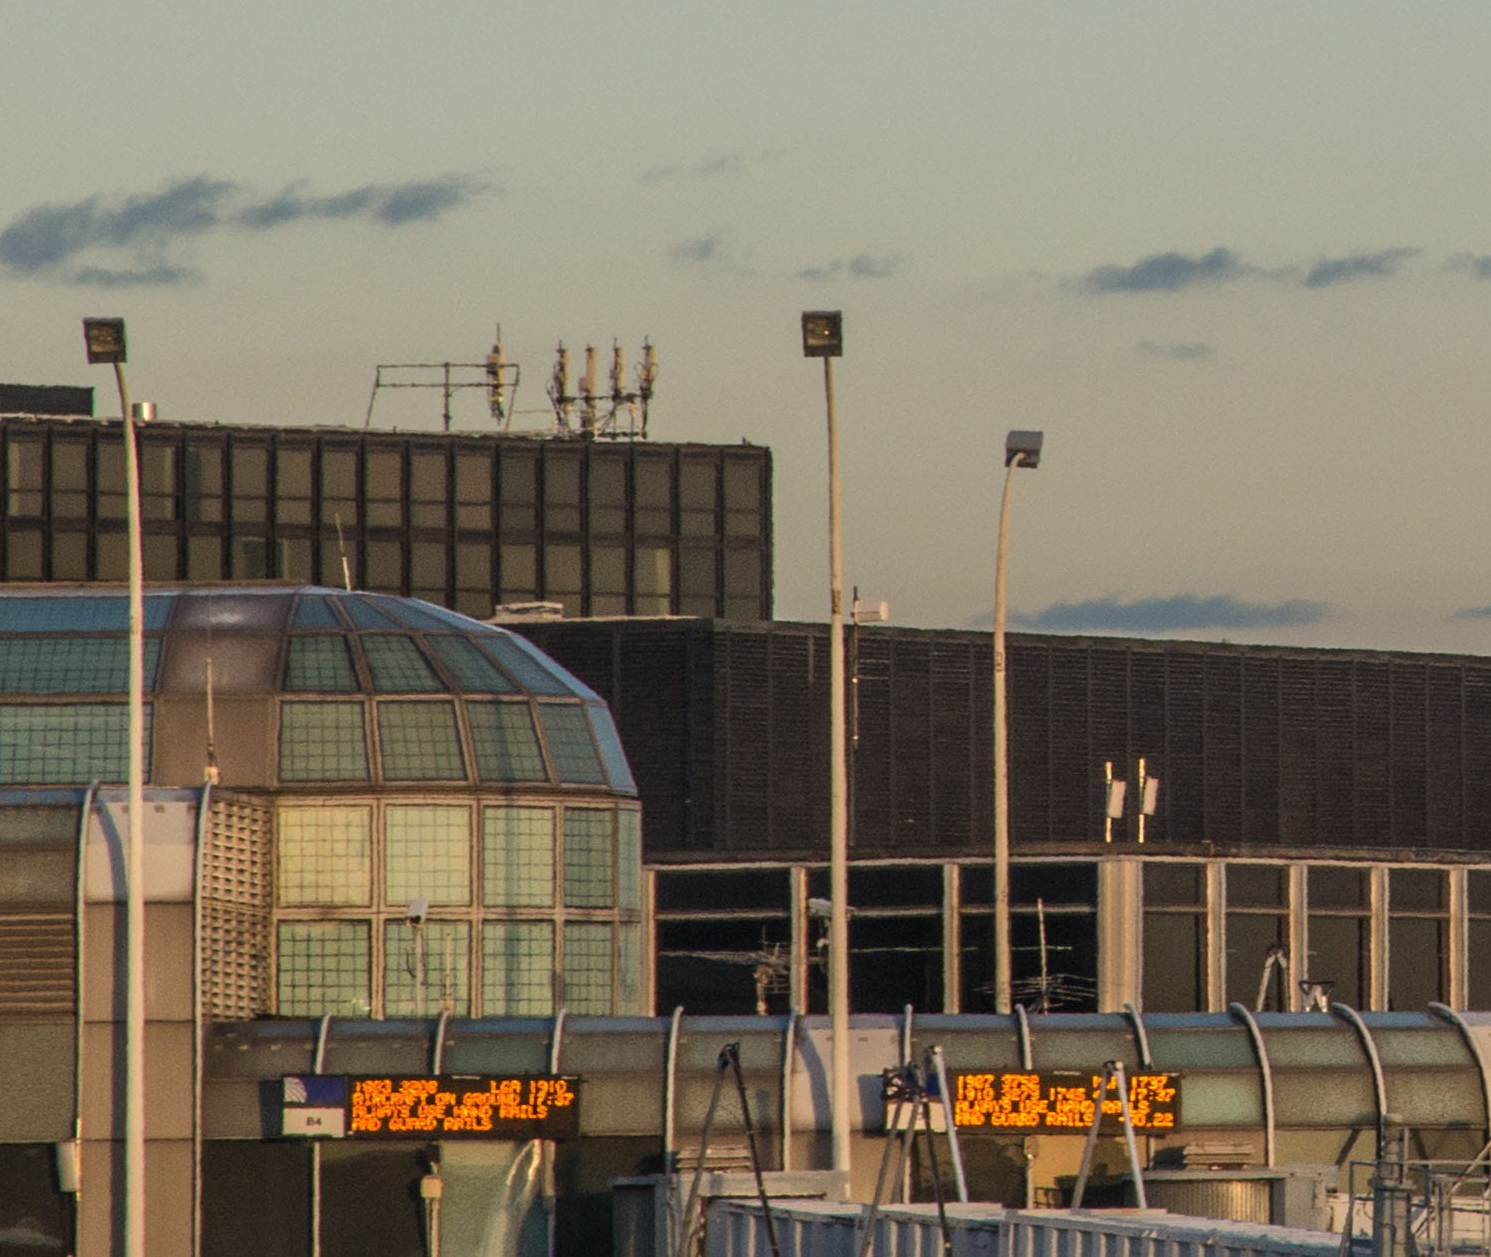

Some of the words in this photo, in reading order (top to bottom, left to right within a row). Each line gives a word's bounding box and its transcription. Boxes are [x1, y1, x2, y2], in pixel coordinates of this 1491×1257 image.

[352, 1092, 428, 1106] AIRCRAFT
[435, 1092, 456, 1105] ON
[463, 1092, 520, 1106] GROUND
[352, 1105, 410, 1118] ALWAYS
[417, 1105, 446, 1118] USE
[453, 1105, 492, 1118] HAND
[500, 1105, 548, 1118] RAILS
[955, 1100, 1012, 1113] ALWAYS
[1019, 1100, 1048, 1113] USE
[1056, 1100, 1095, 1113] HAND
[1101, 1100, 1150, 1113] RALS
[351, 1117, 382, 1131] AND
[389, 1117, 437, 1131] GUARD
[444, 1117, 493, 1131] RAILS
[954, 1112, 985, 1126] AND
[991, 1112, 1039, 1126] GUARD
[1046, 1112, 1094, 1126] RAILS
